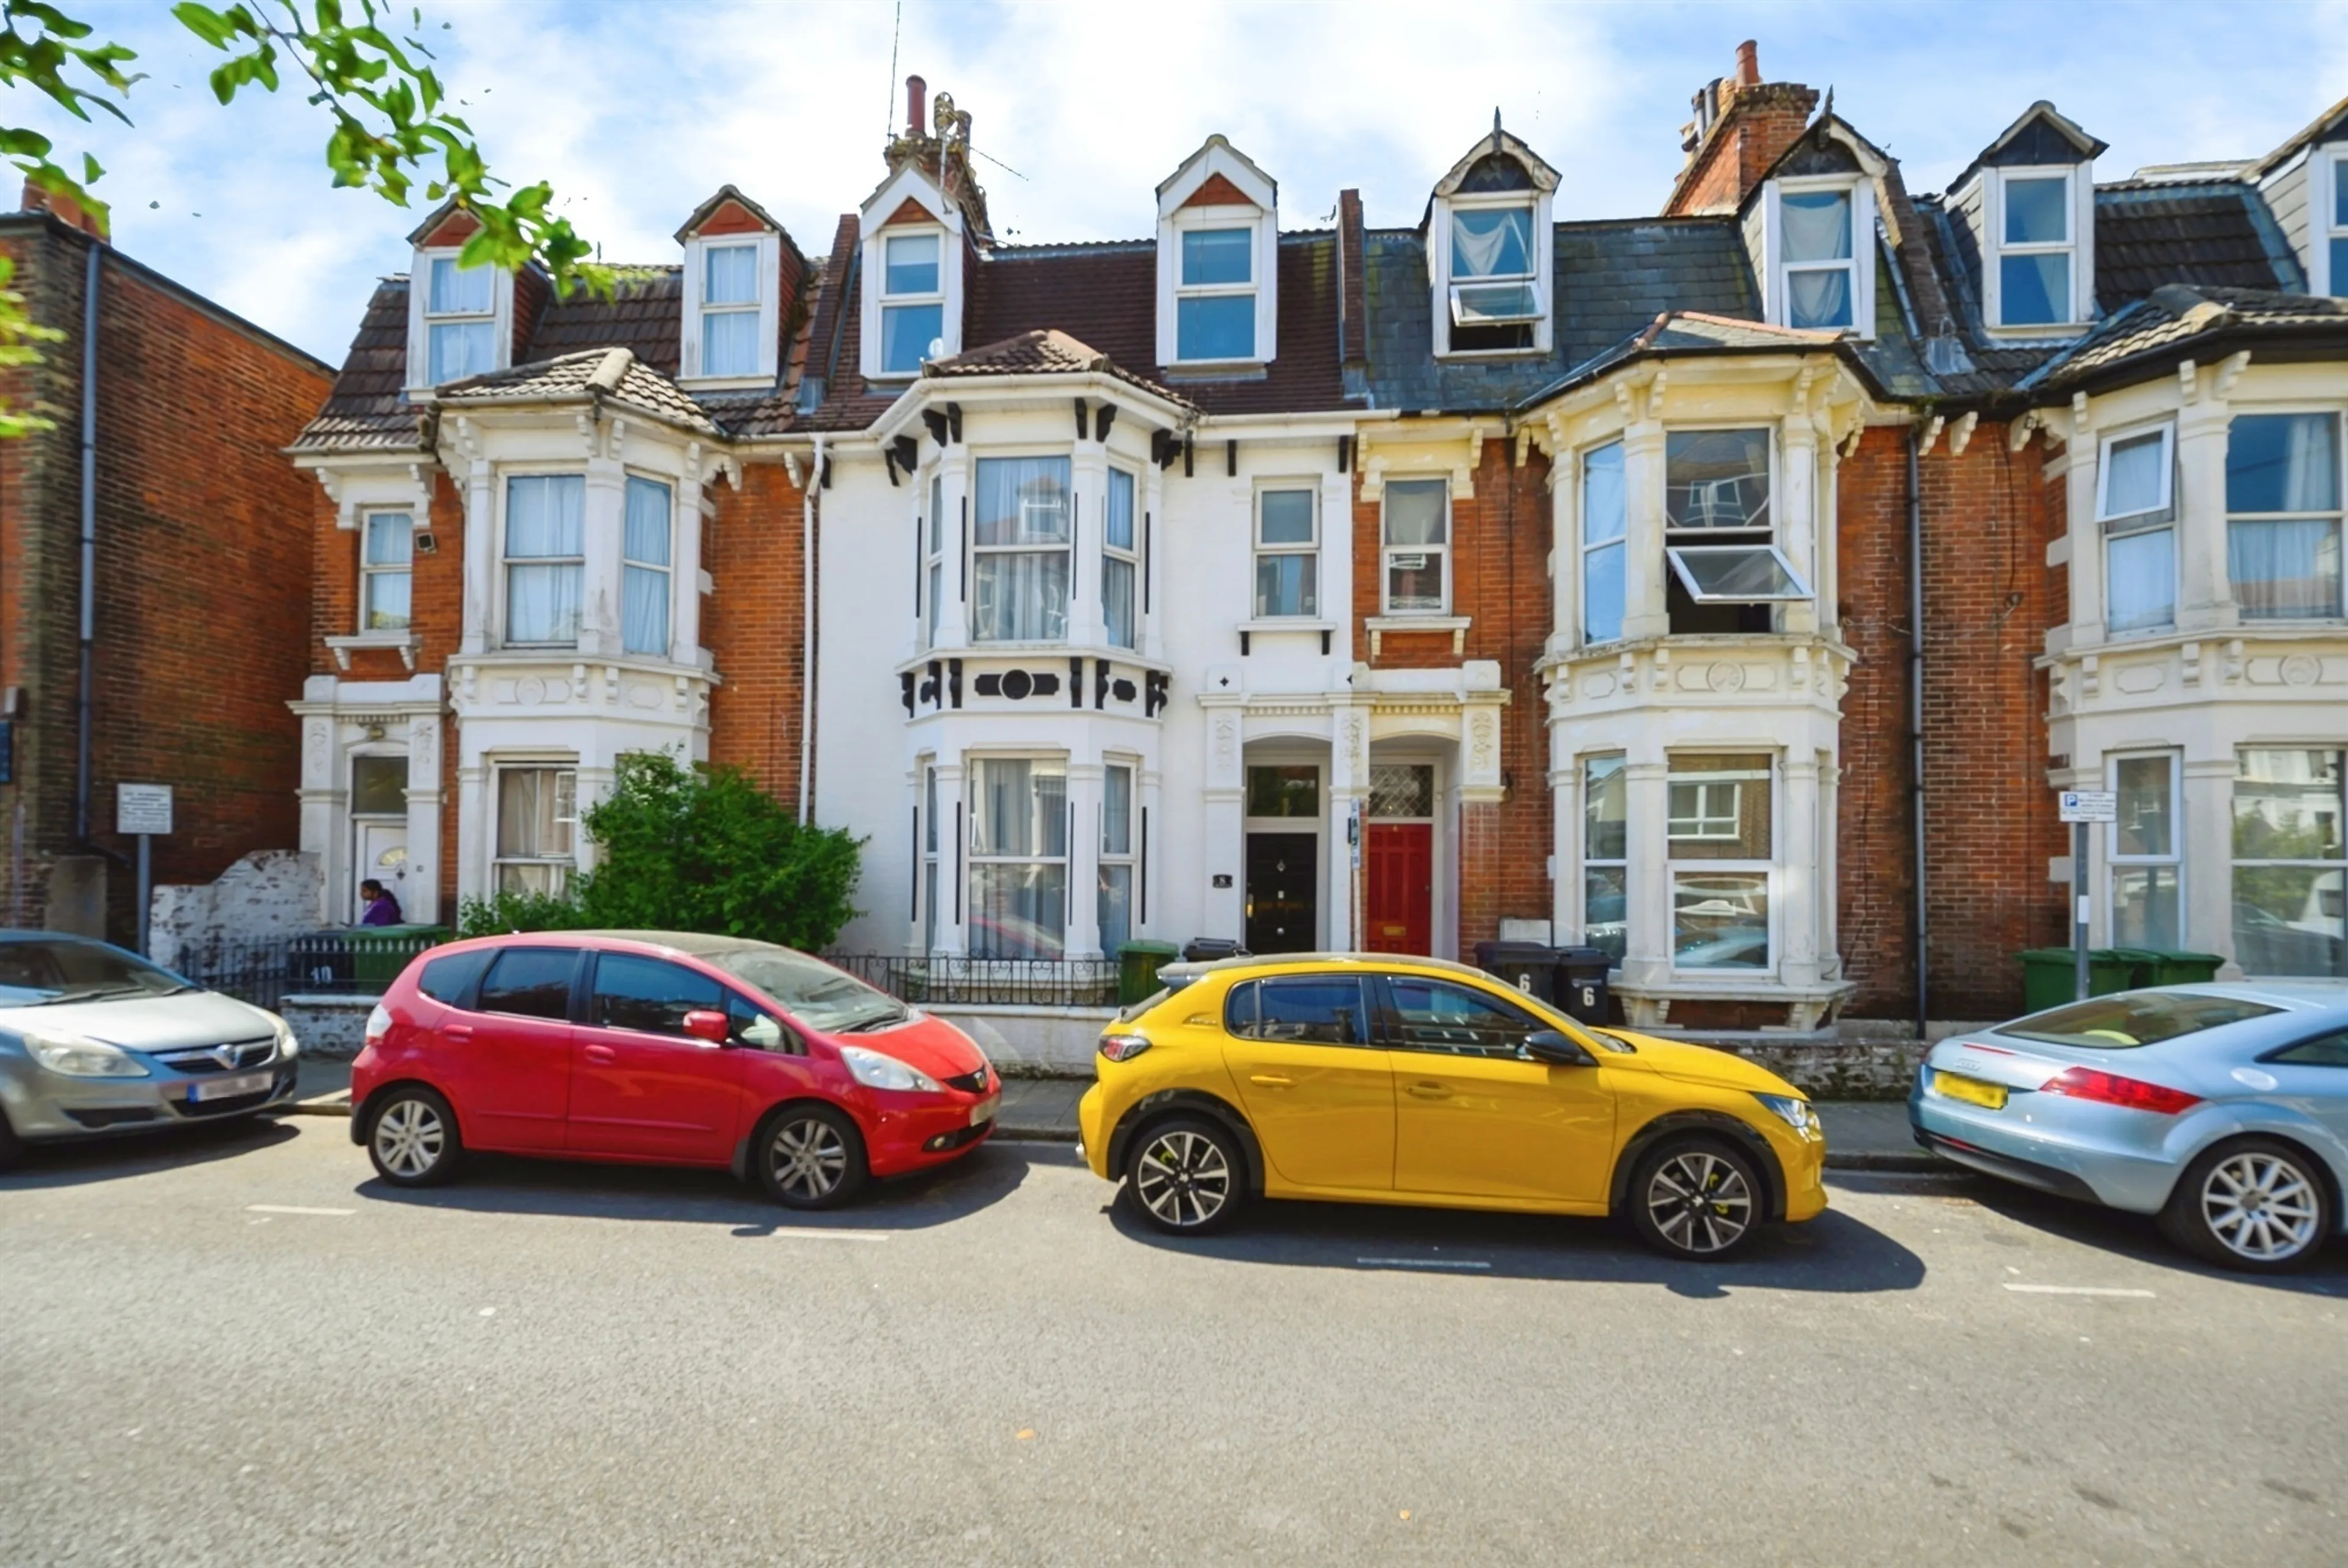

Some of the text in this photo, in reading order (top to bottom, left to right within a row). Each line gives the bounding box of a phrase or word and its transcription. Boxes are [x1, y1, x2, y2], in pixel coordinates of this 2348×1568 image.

[2067, 795, 2077, 806] P
[310, 966, 332, 984] 10
[1519, 973, 1530, 993] 6
[1582, 987, 1595, 1006] 6
